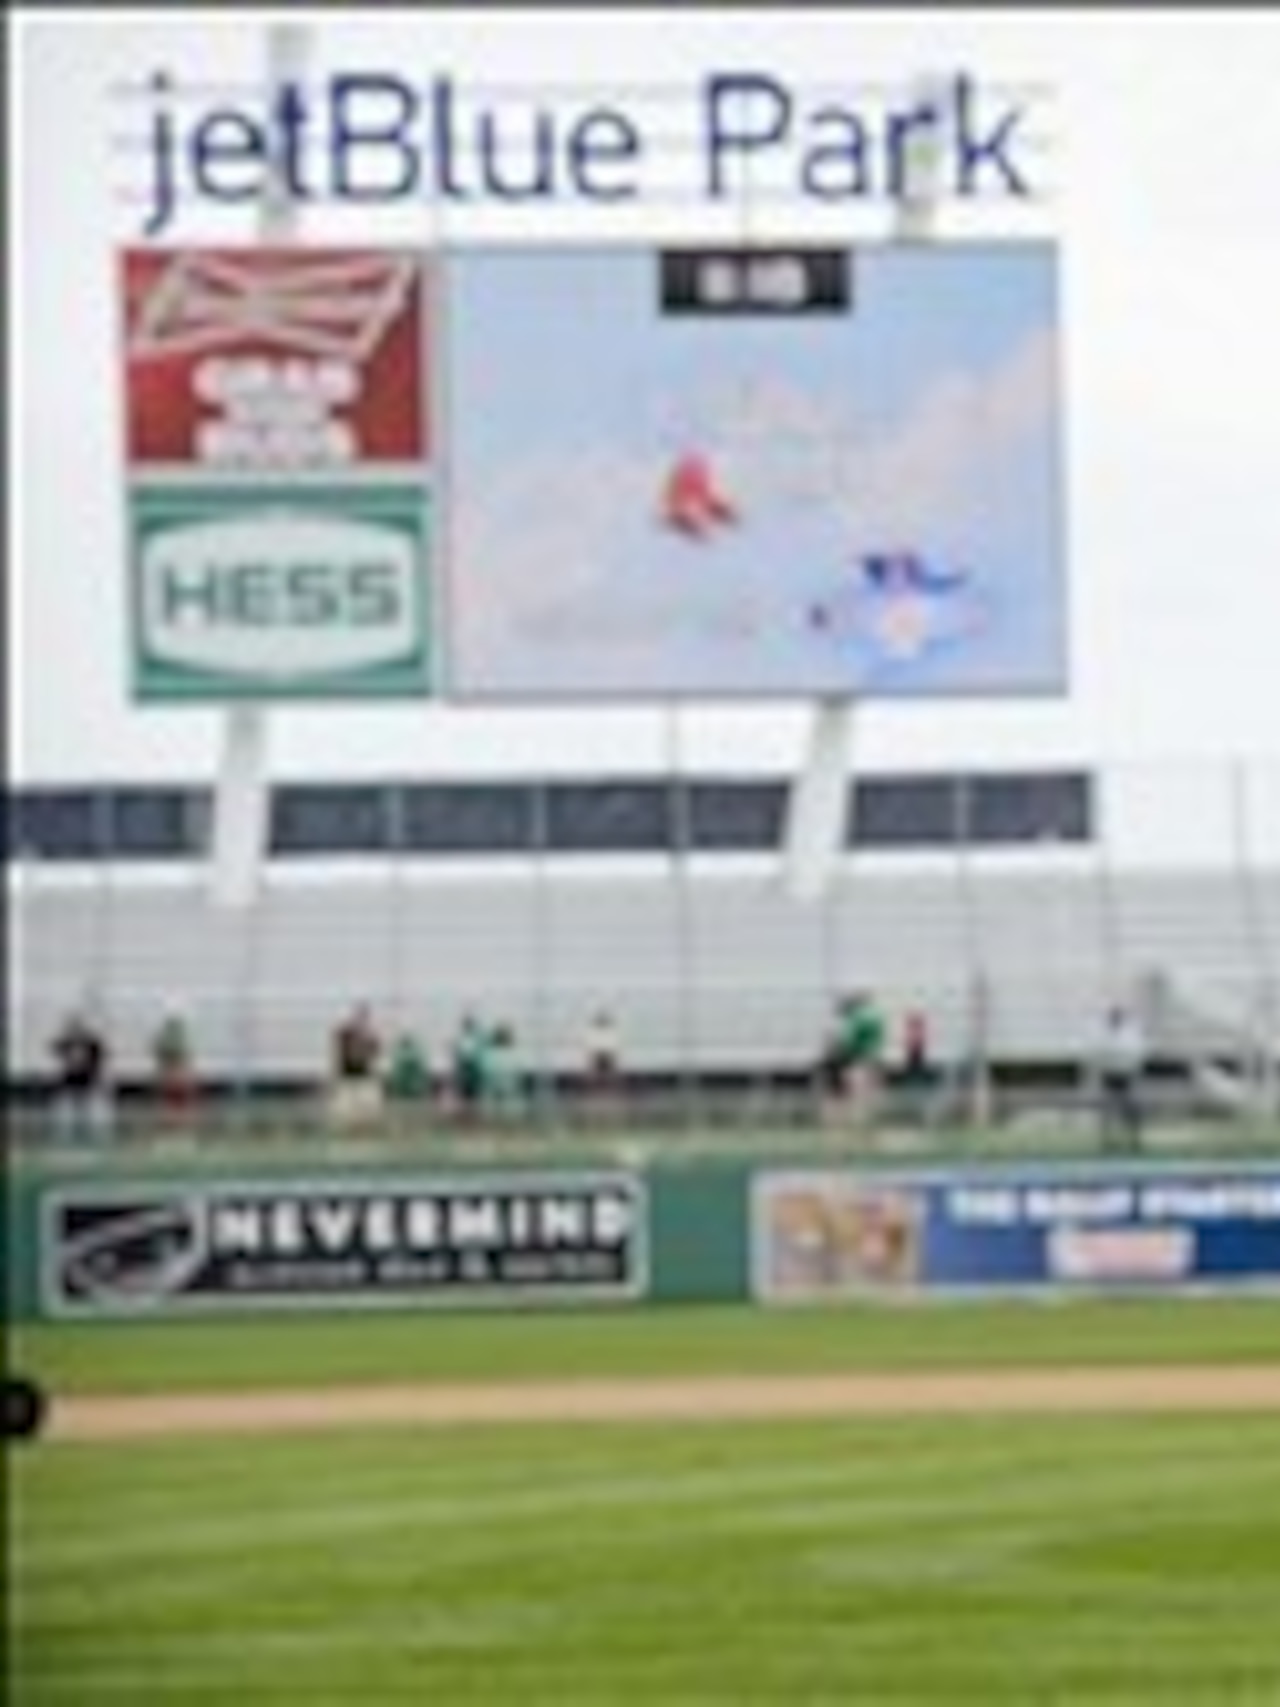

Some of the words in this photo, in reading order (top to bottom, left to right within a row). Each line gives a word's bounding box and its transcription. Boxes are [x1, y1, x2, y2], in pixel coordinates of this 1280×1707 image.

[144, 72, 640, 236] jetBlue
[702, 72, 1030, 198] Park
[163, 562, 401, 630] HESS
[213, 1196, 632, 1254] NEVERMIND
